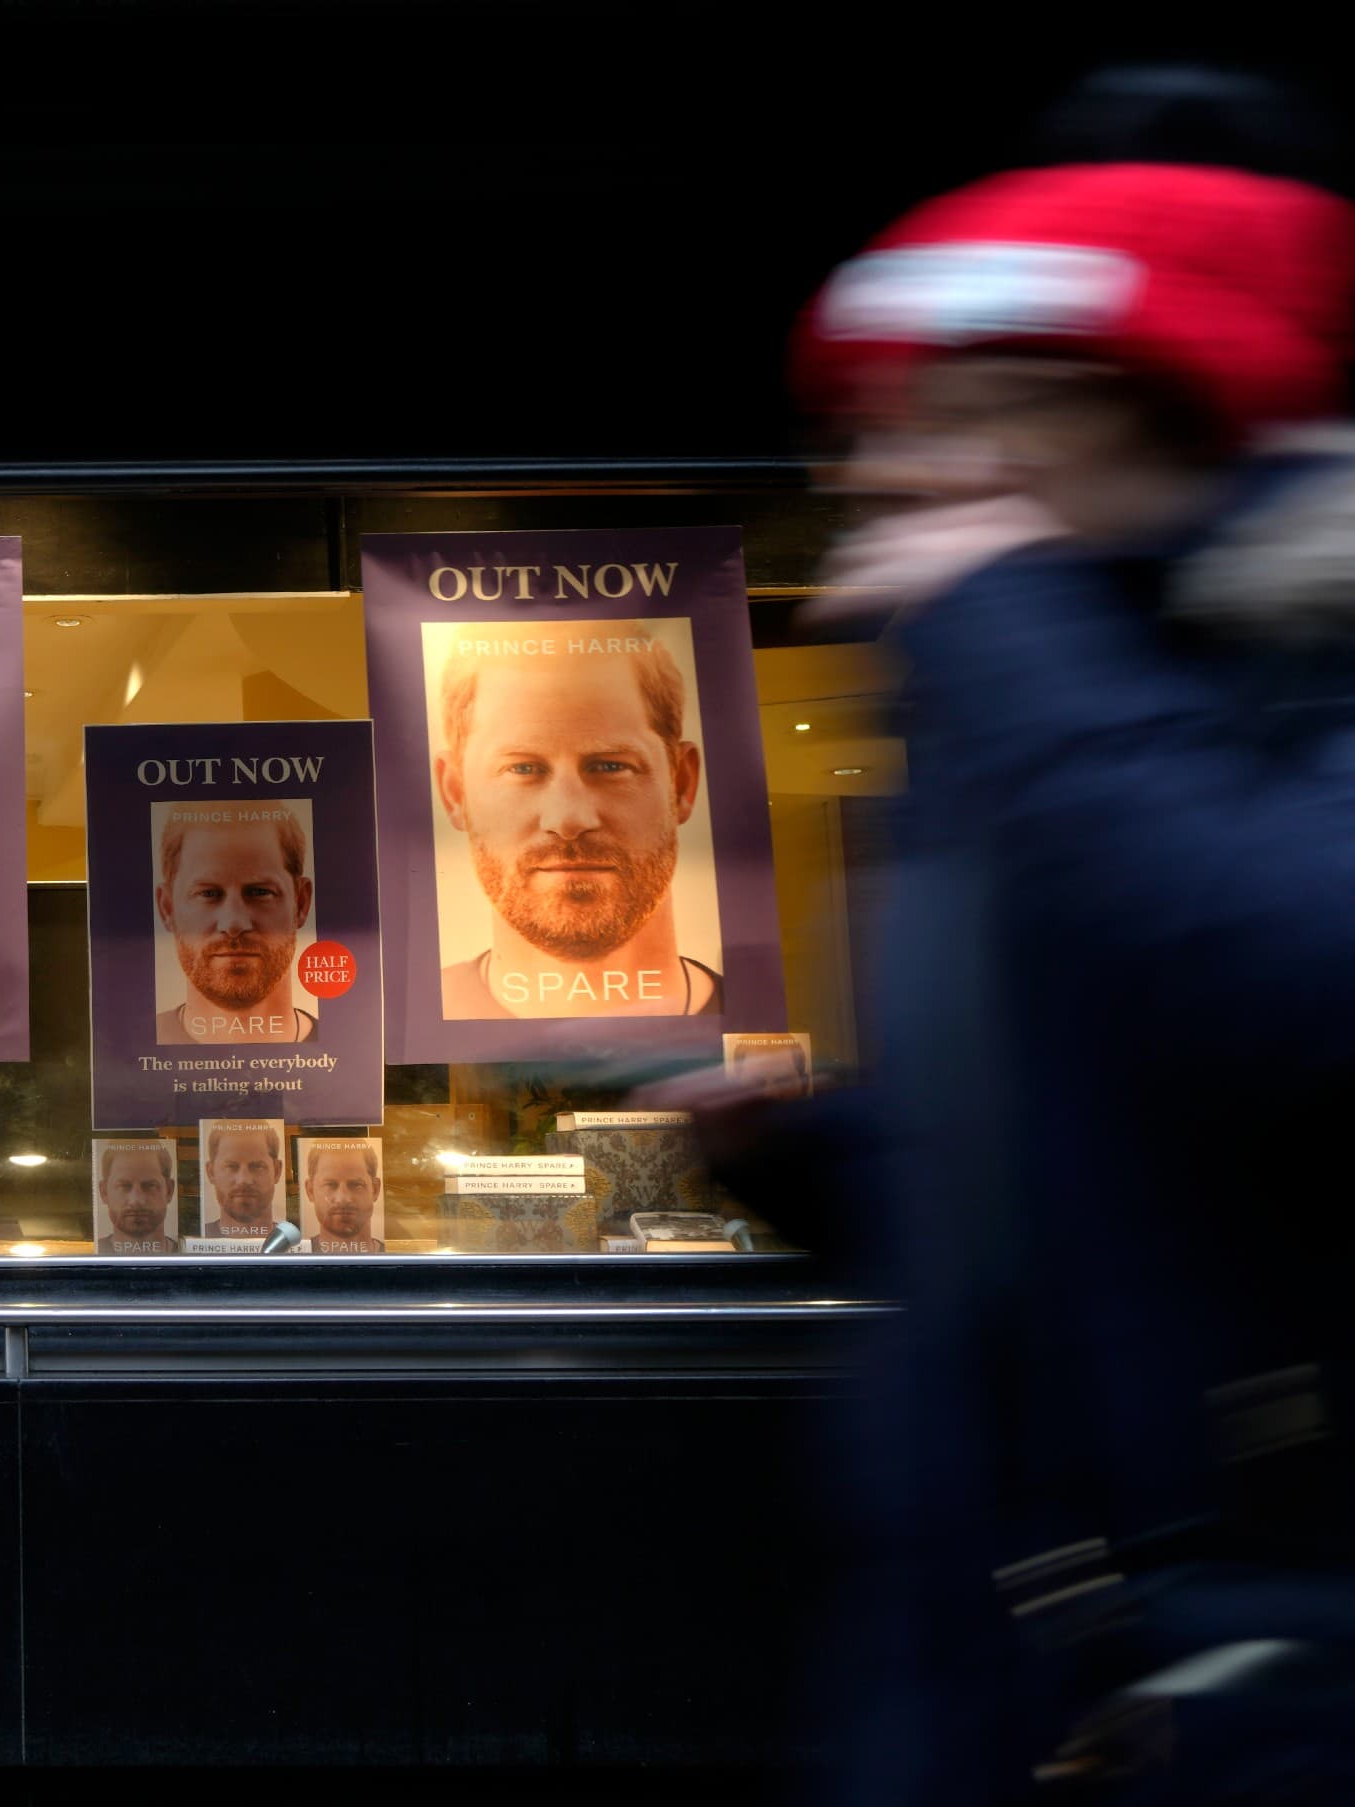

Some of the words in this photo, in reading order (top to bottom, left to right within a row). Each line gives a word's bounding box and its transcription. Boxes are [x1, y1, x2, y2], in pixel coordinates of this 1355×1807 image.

[429, 565, 540, 602] OUT
[552, 562, 679, 600] NOW
[459, 639, 556, 657] PRINCE
[568, 637, 657, 655] HARRY
[137, 758, 221, 786] OUT
[232, 755, 325, 784] NOW
[172, 811, 233, 823] PRINCE
[237, 810, 292, 822] HARRY
[305, 955, 349, 969] HALF
[303, 970, 350, 985] PRICE
[501, 970, 664, 1003] SPARE
[191, 1015, 285, 1036] SPARE
[138, 1055, 174, 1072] The
[178, 1055, 244, 1071] memoir
[250, 1053, 338, 1073] everybody
[173, 1078, 187, 1093] is
[191, 1077, 249, 1096] talking
[254, 1077, 303, 1092] about
[581, 1116, 614, 1124] PRINCE
[617, 1116, 648, 1124] HARRY
[653, 1116, 682, 1124] SPARE
[107, 1143, 138, 1151] PRINCE
[139, 1143, 167, 1151] HARRY
[310, 1142, 342, 1150] PRINCE
[344, 1142, 372, 1150] HARRY
[501, 1161, 532, 1169] HARRY
[538, 1161, 567, 1169] SPARE
[221, 1226, 269, 1235] SPARE
[114, 1241, 162, 1252] SPARE
[192, 1244, 227, 1253] PRINCE
[230, 1244, 261, 1253] HARRY
[320, 1241, 368, 1252] SPARE
